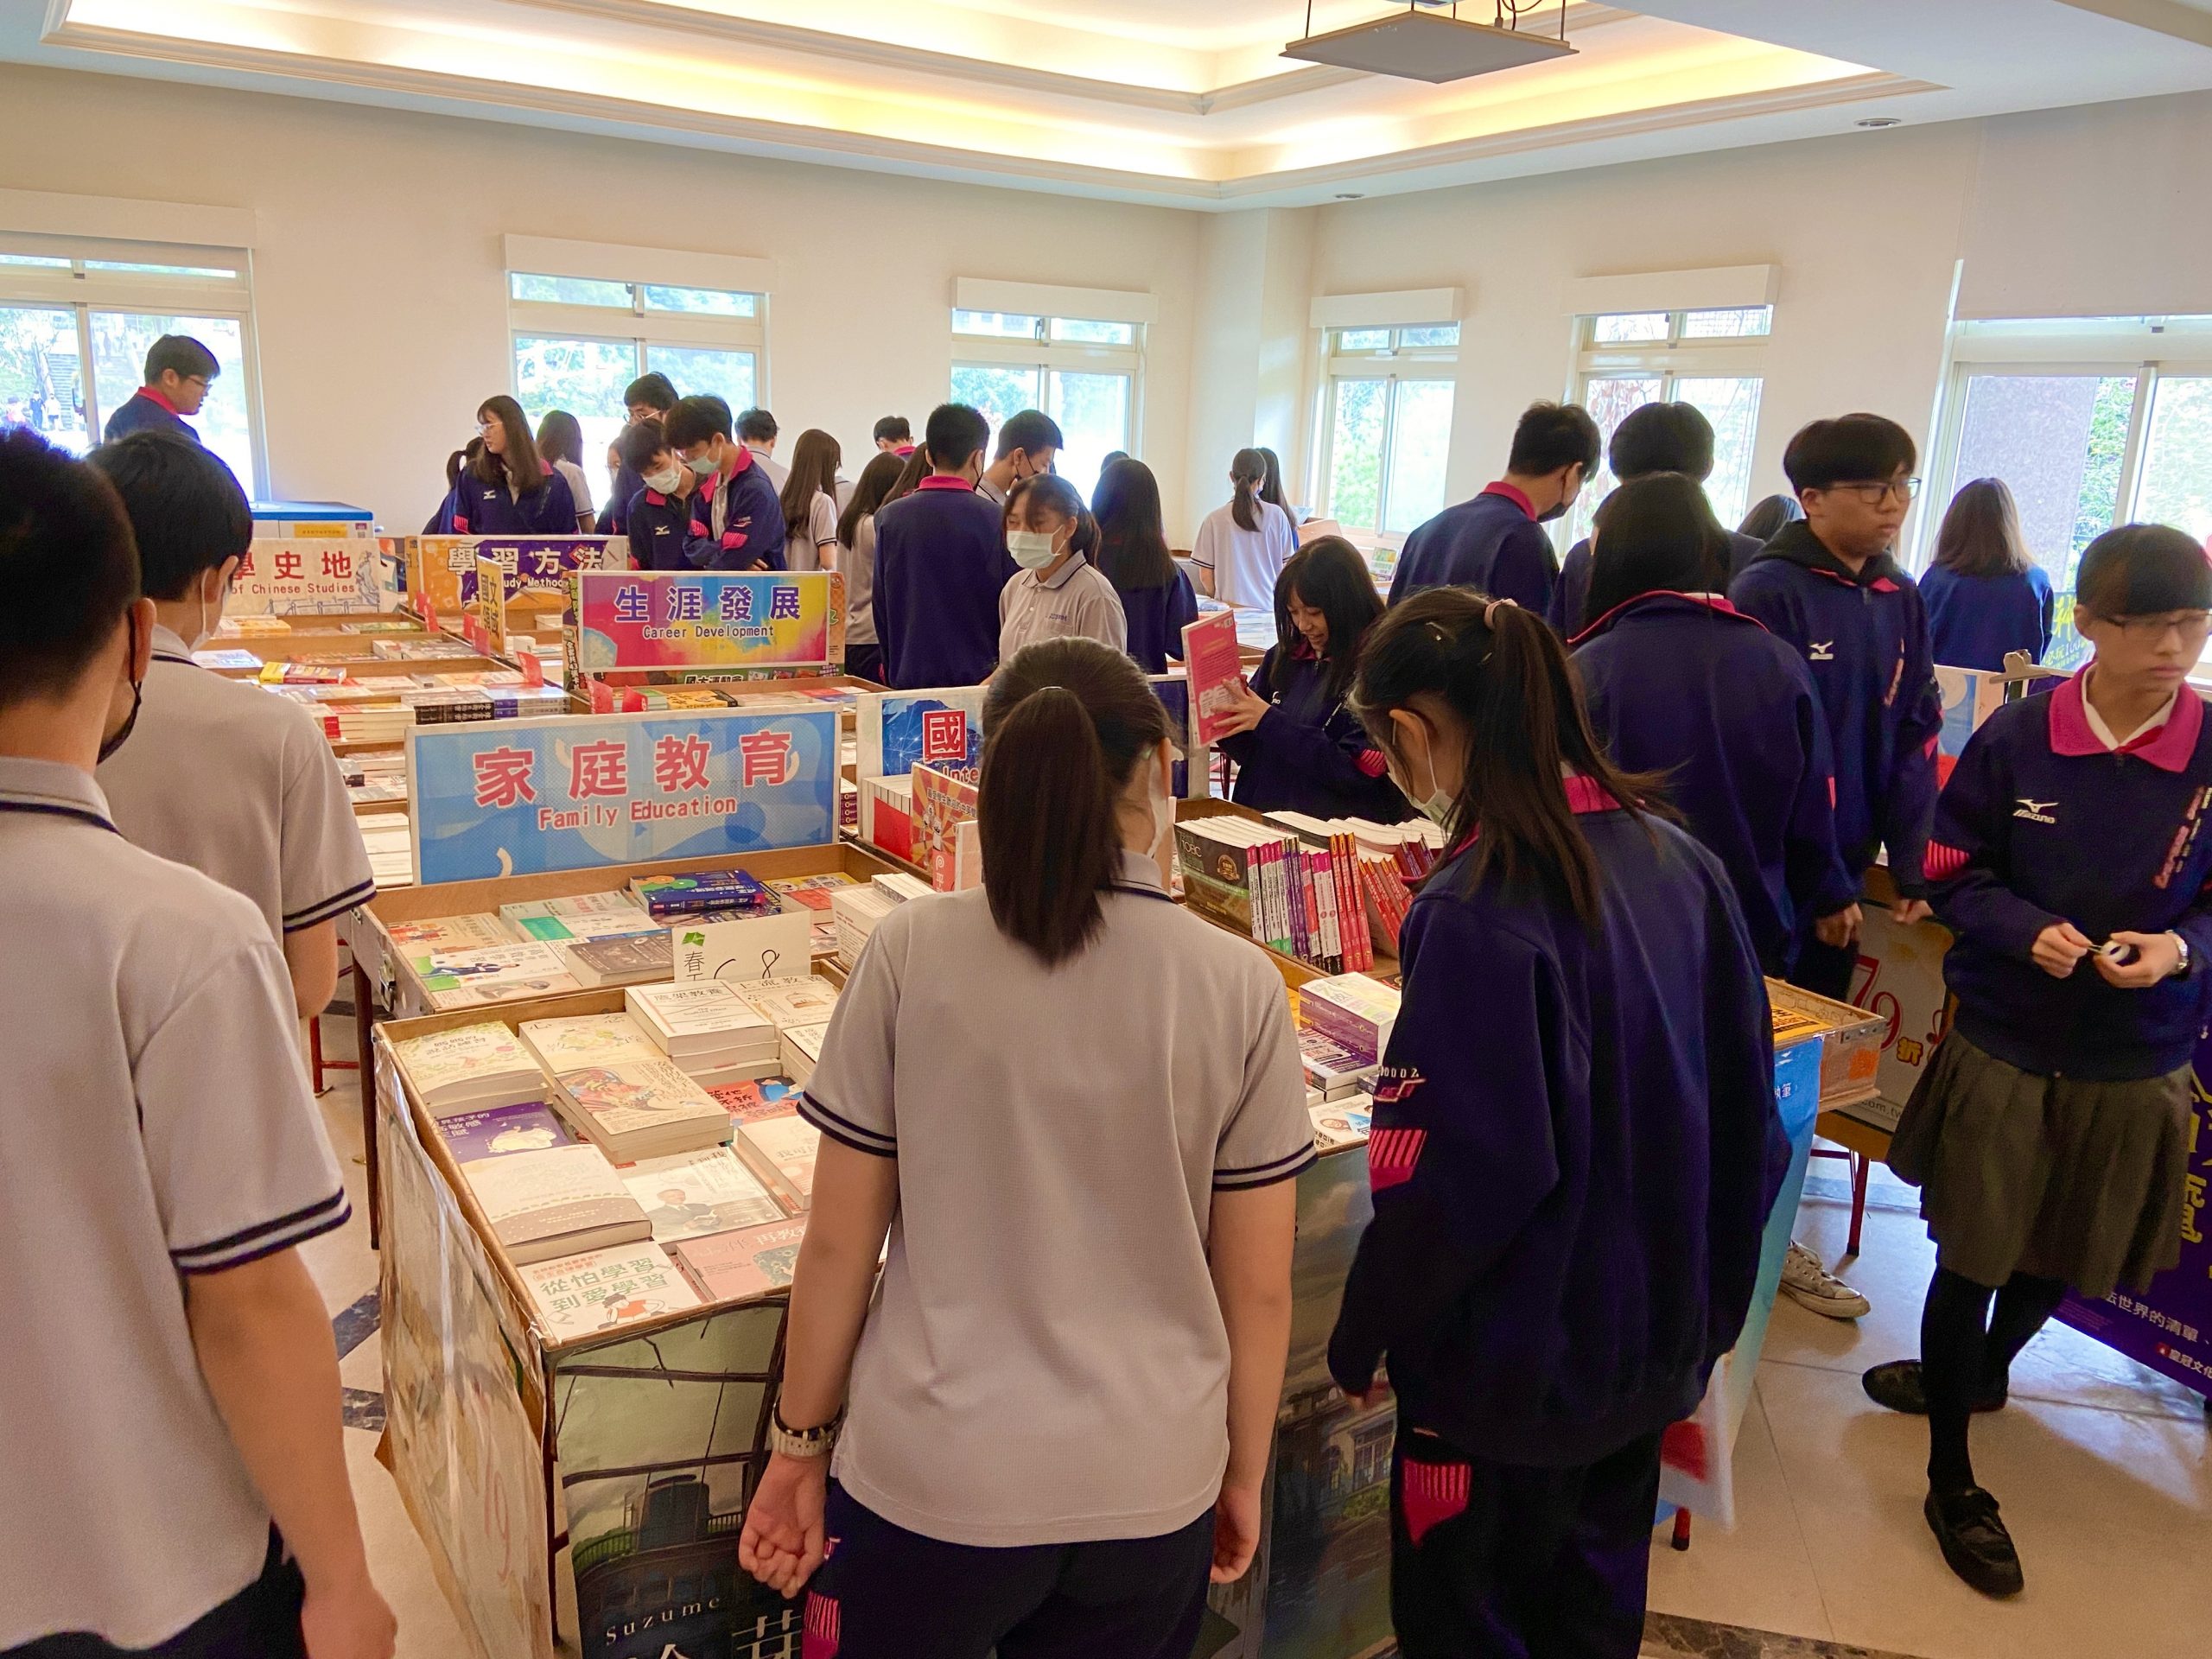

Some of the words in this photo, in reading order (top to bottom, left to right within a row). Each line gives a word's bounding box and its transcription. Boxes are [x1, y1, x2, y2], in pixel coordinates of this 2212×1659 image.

[448, 545, 603, 575] 學習方法
[251, 583, 301, 594] Chinese
[307, 582, 355, 594] Studies
[503, 577, 521, 589] udy
[614, 585, 801, 623] 生涯發展
[642, 625, 687, 640] Career
[695, 624, 775, 640] Development
[923, 710, 968, 763] 國
[472, 729, 794, 810] 家庭教育
[537, 804, 618, 831] Family
[631, 795, 738, 820] Education
[540, 1257, 655, 1296] 從怕學習
[550, 1274, 668, 1313] 到愛學習
[607, 1597, 721, 1646] Suzume
